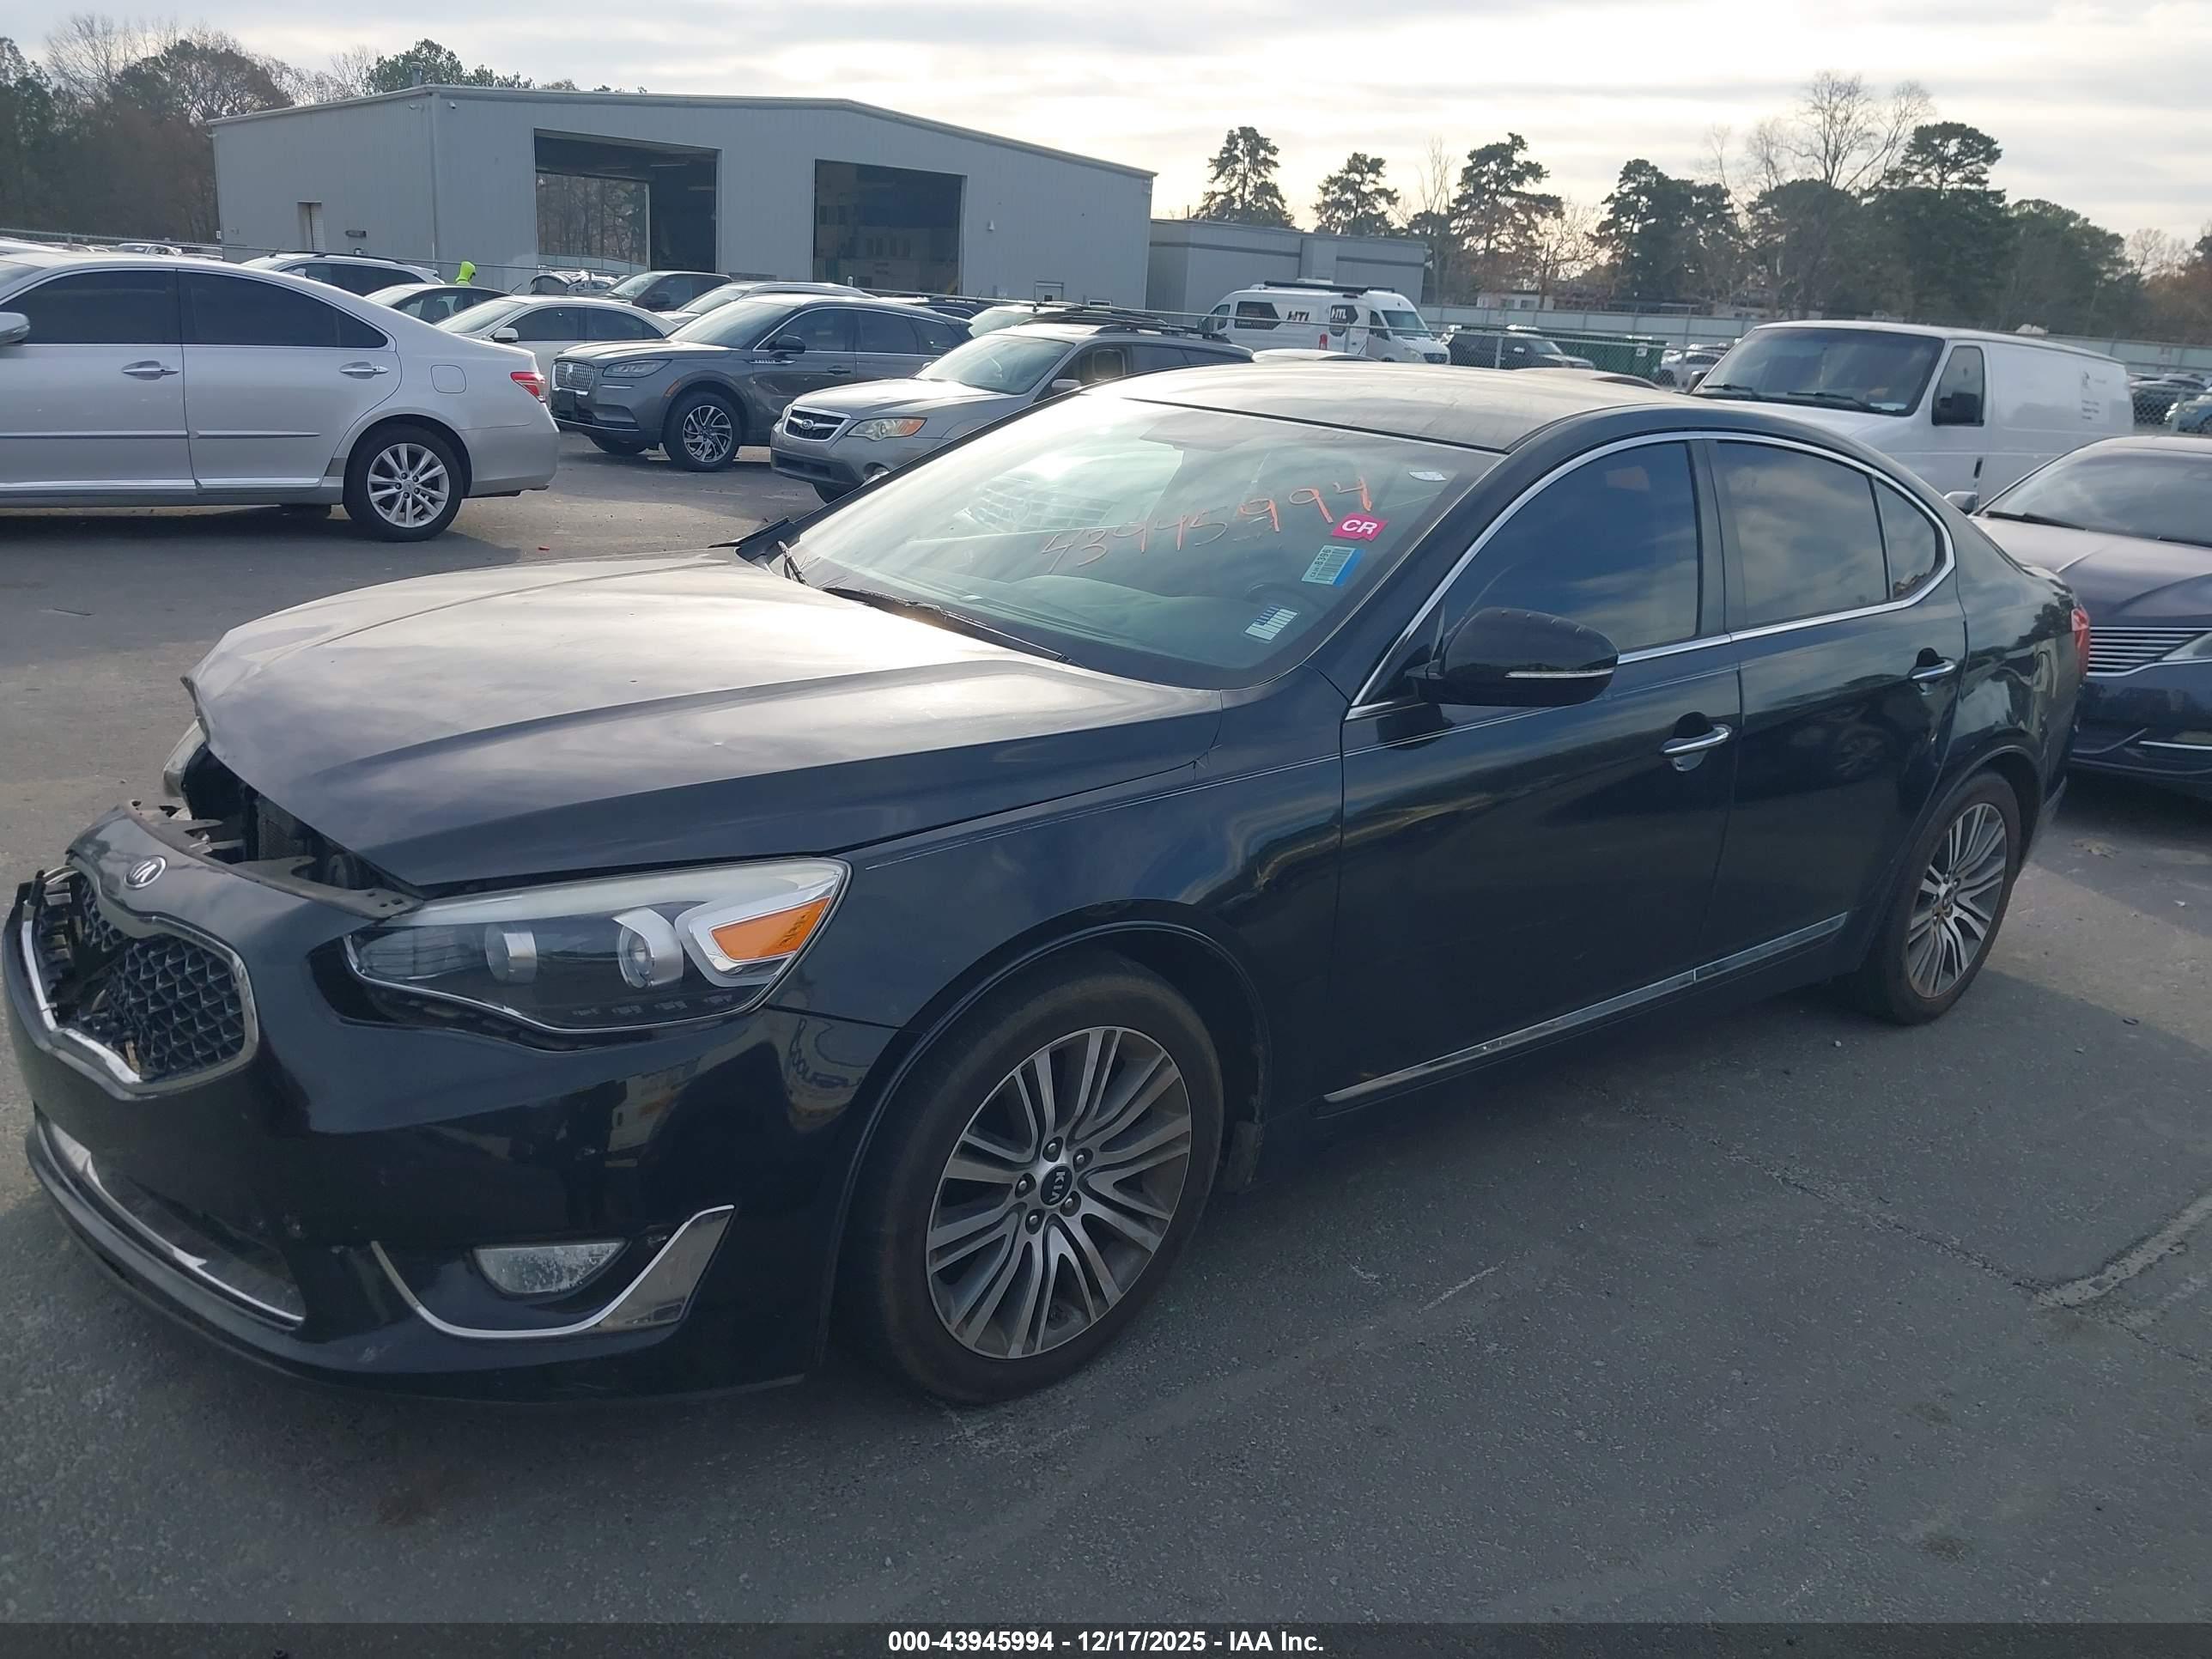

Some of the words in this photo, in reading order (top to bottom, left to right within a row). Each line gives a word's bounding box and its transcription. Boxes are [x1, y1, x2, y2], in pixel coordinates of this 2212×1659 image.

[1041, 476, 1372, 574] 43945994
[1341, 520, 1378, 535] CR
[1048, 1171, 1066, 1202] KIA
